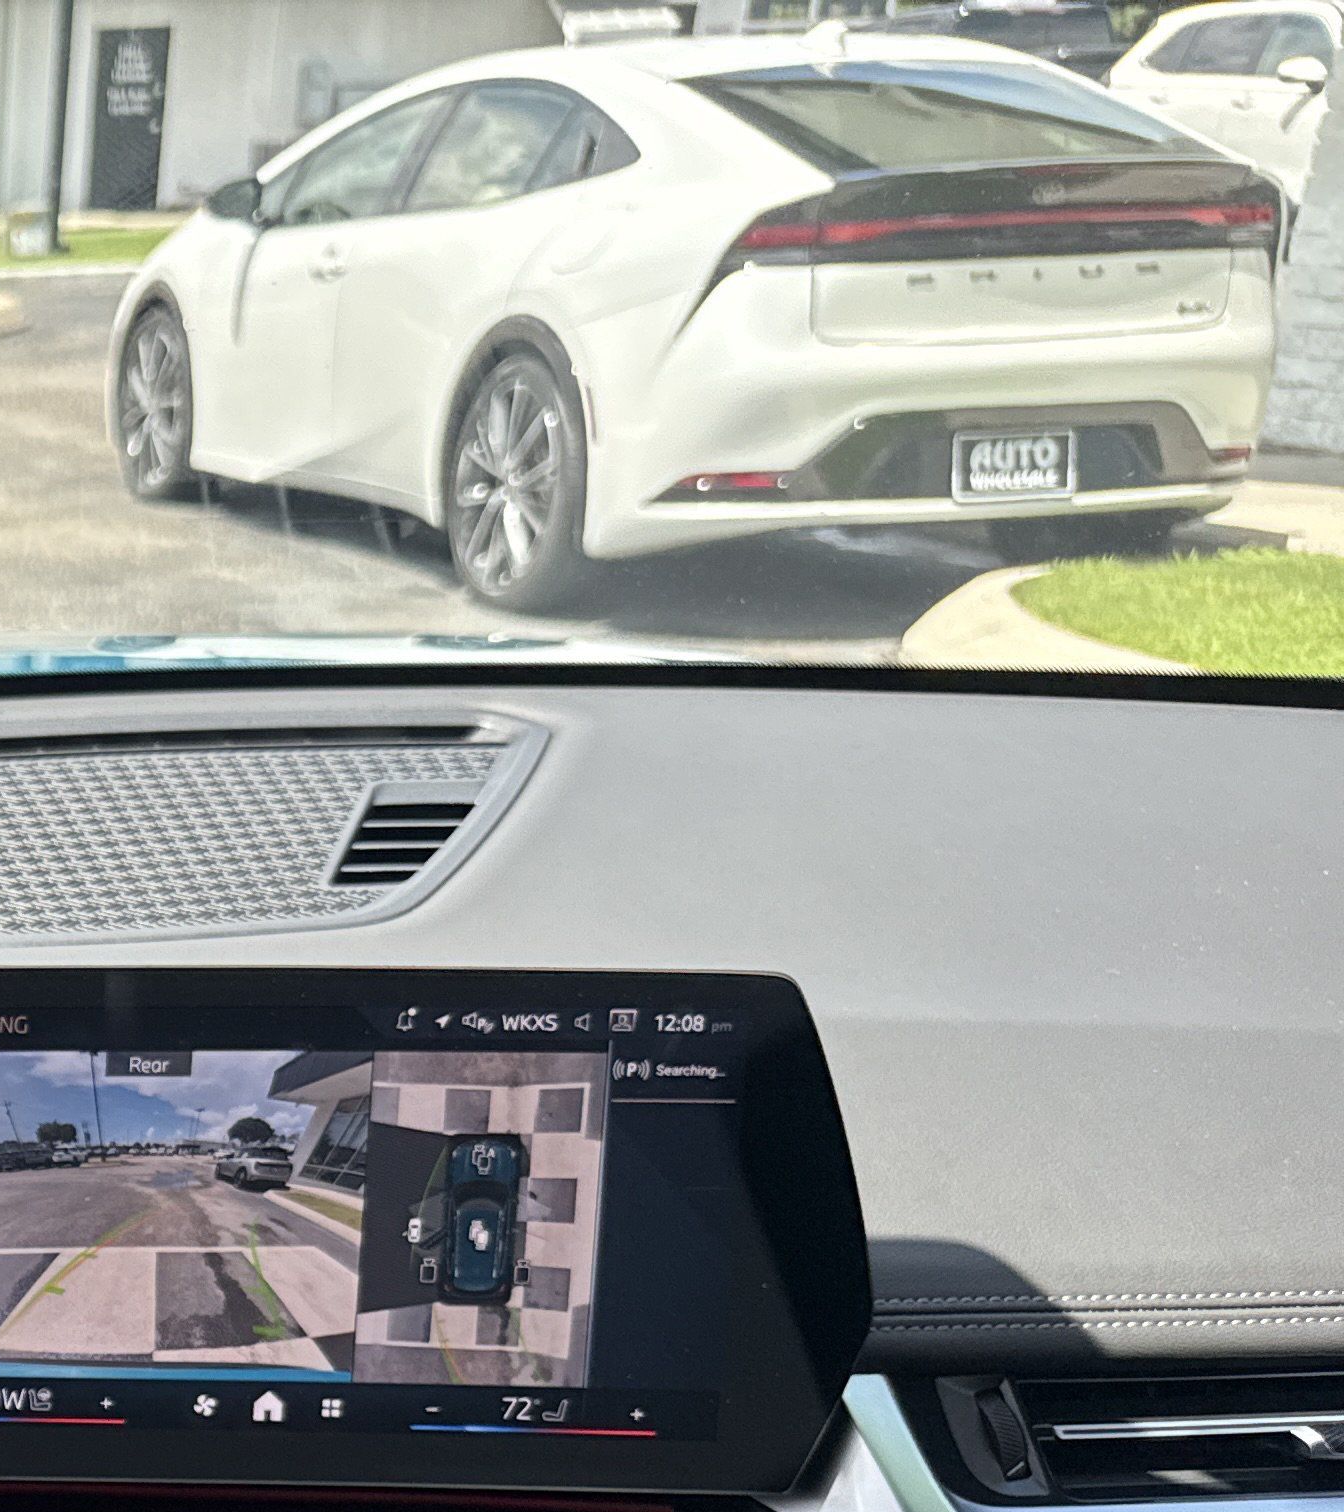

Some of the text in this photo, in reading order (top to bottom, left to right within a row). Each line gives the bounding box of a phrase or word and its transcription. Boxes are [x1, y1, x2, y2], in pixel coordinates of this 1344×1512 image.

[970, 438, 1059, 471] AUTO
[502, 1014, 559, 1032] WKXS
[654, 1014, 733, 1034] 12:08 pm
[129, 1056, 170, 1073] Rear
